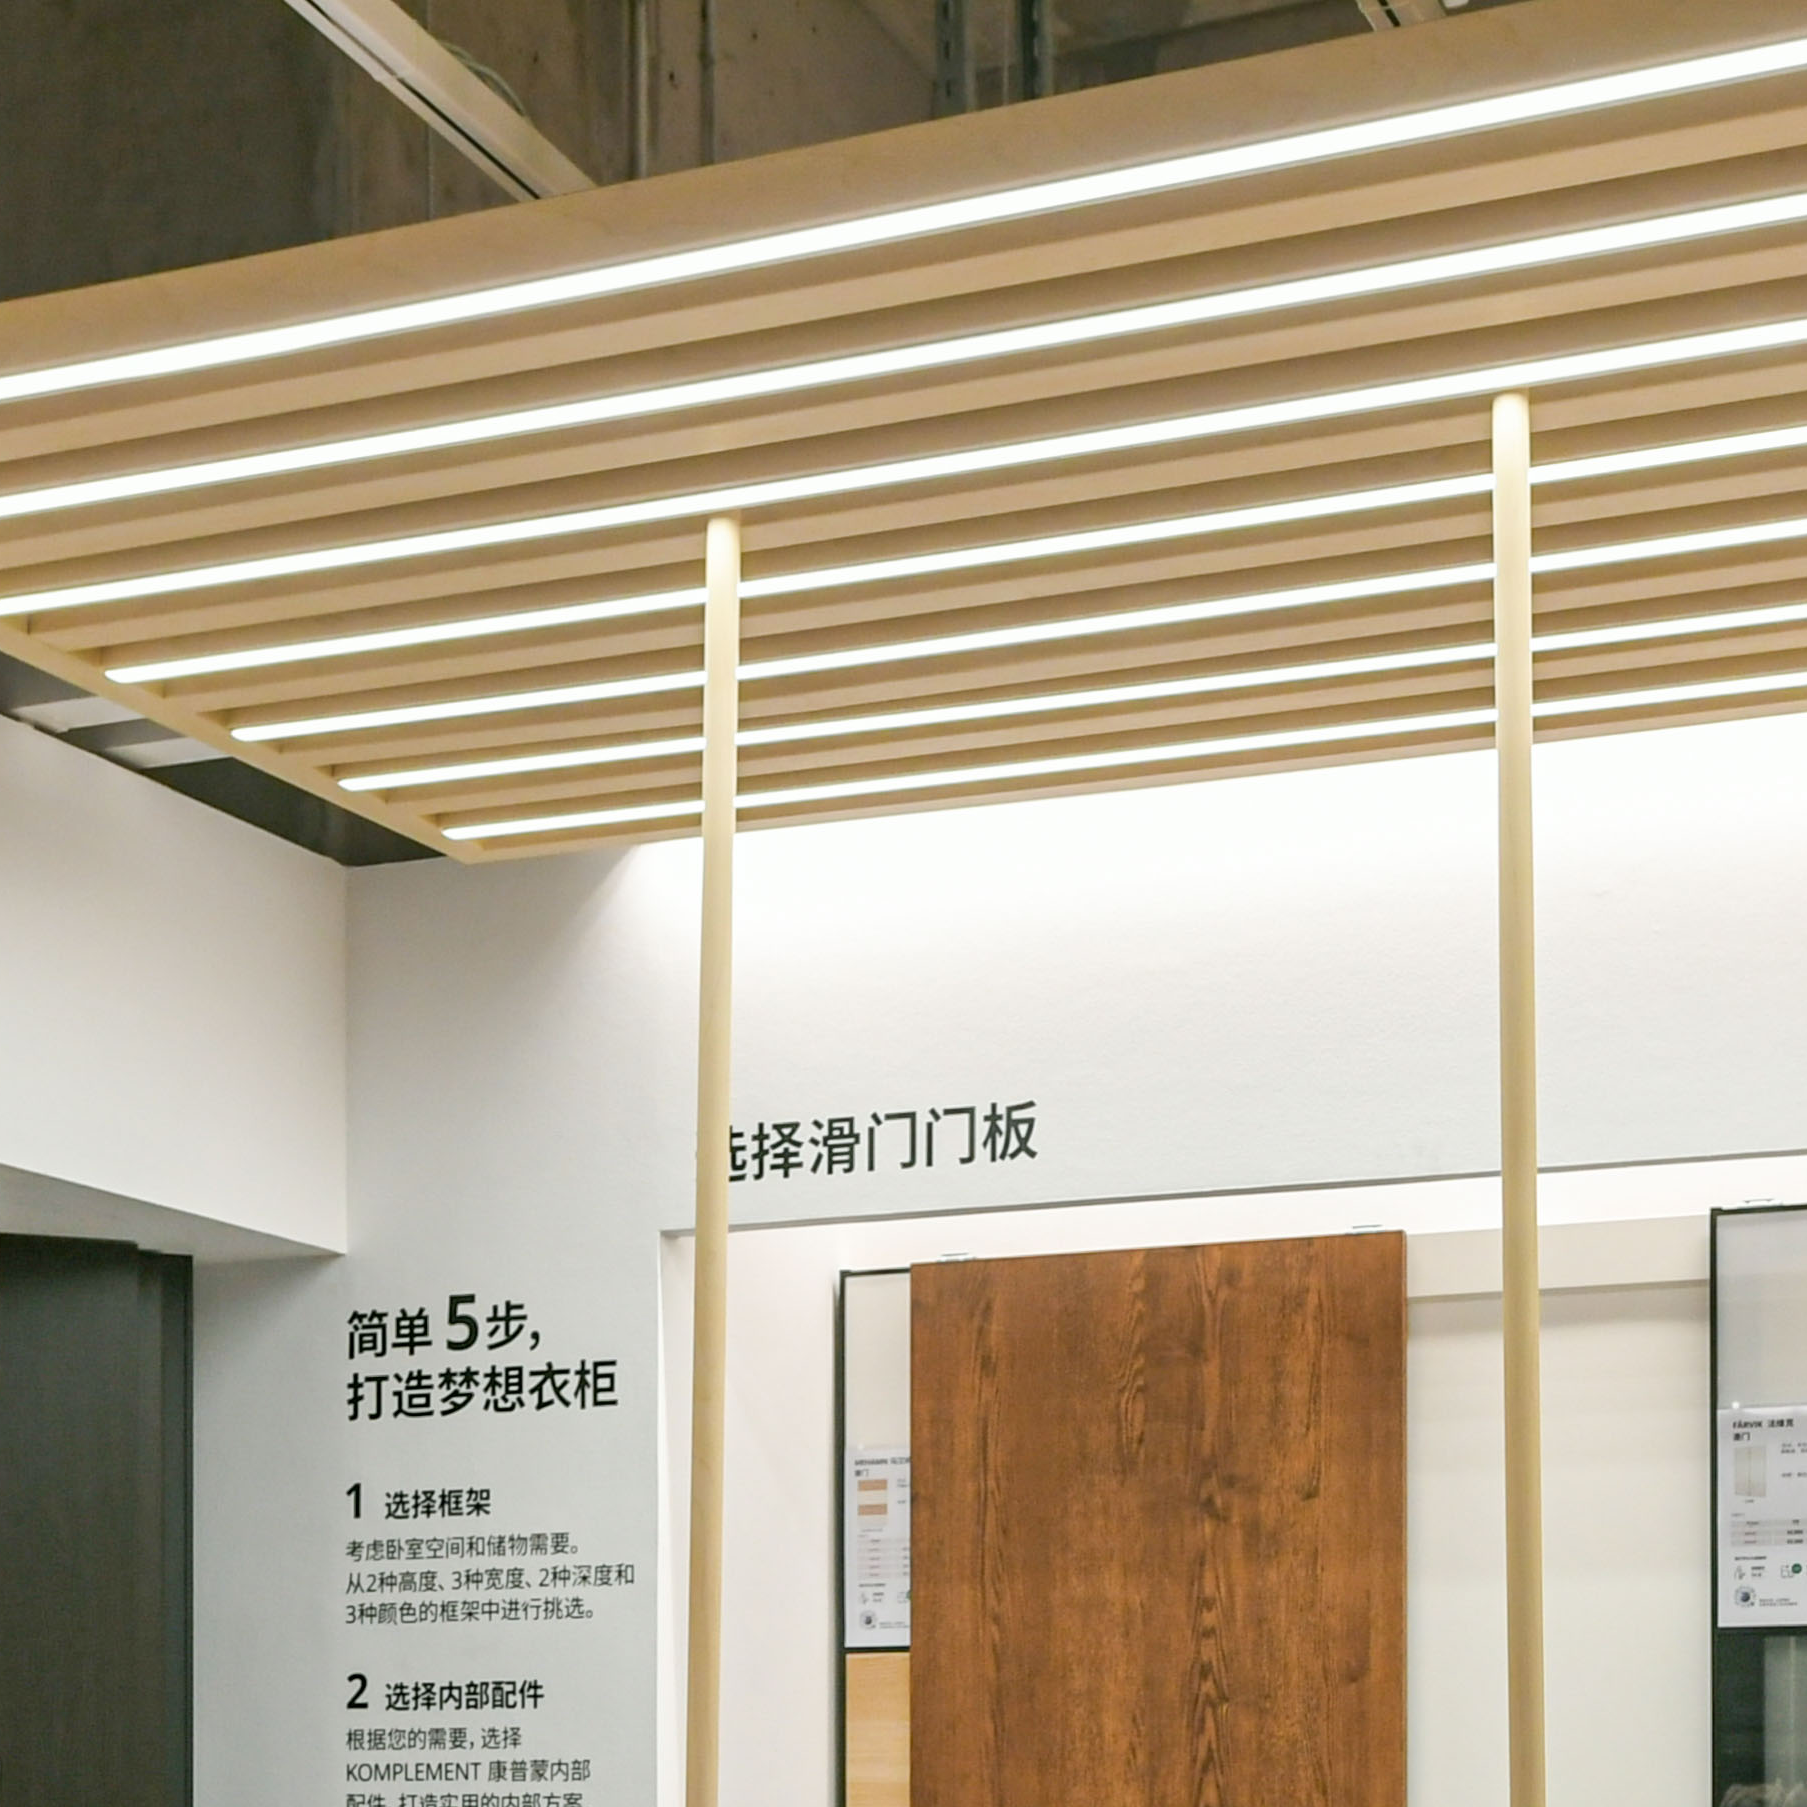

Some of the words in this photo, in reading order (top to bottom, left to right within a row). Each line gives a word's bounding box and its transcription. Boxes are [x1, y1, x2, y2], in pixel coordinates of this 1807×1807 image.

[346, 1359, 619, 1421] 打造梦想衣柜
[346, 1483, 362, 1518] 1
[385, 1488, 491, 1520] 选择框架
[346, 1531, 579, 1562] 考虑卧室空间和储物需要。
[346, 1563, 635, 1595] 从2种高度、3种宽度、2种深度和
[345, 1596, 594, 1625] 3种颜色的框架中进行挑选。
[346, 1673, 369, 1709] 2
[385, 1679, 545, 1711] 选择内部配件
[346, 1762, 482, 1782] KOMPLEMENT
[488, 1759, 591, 1783] 康普蒙内部
